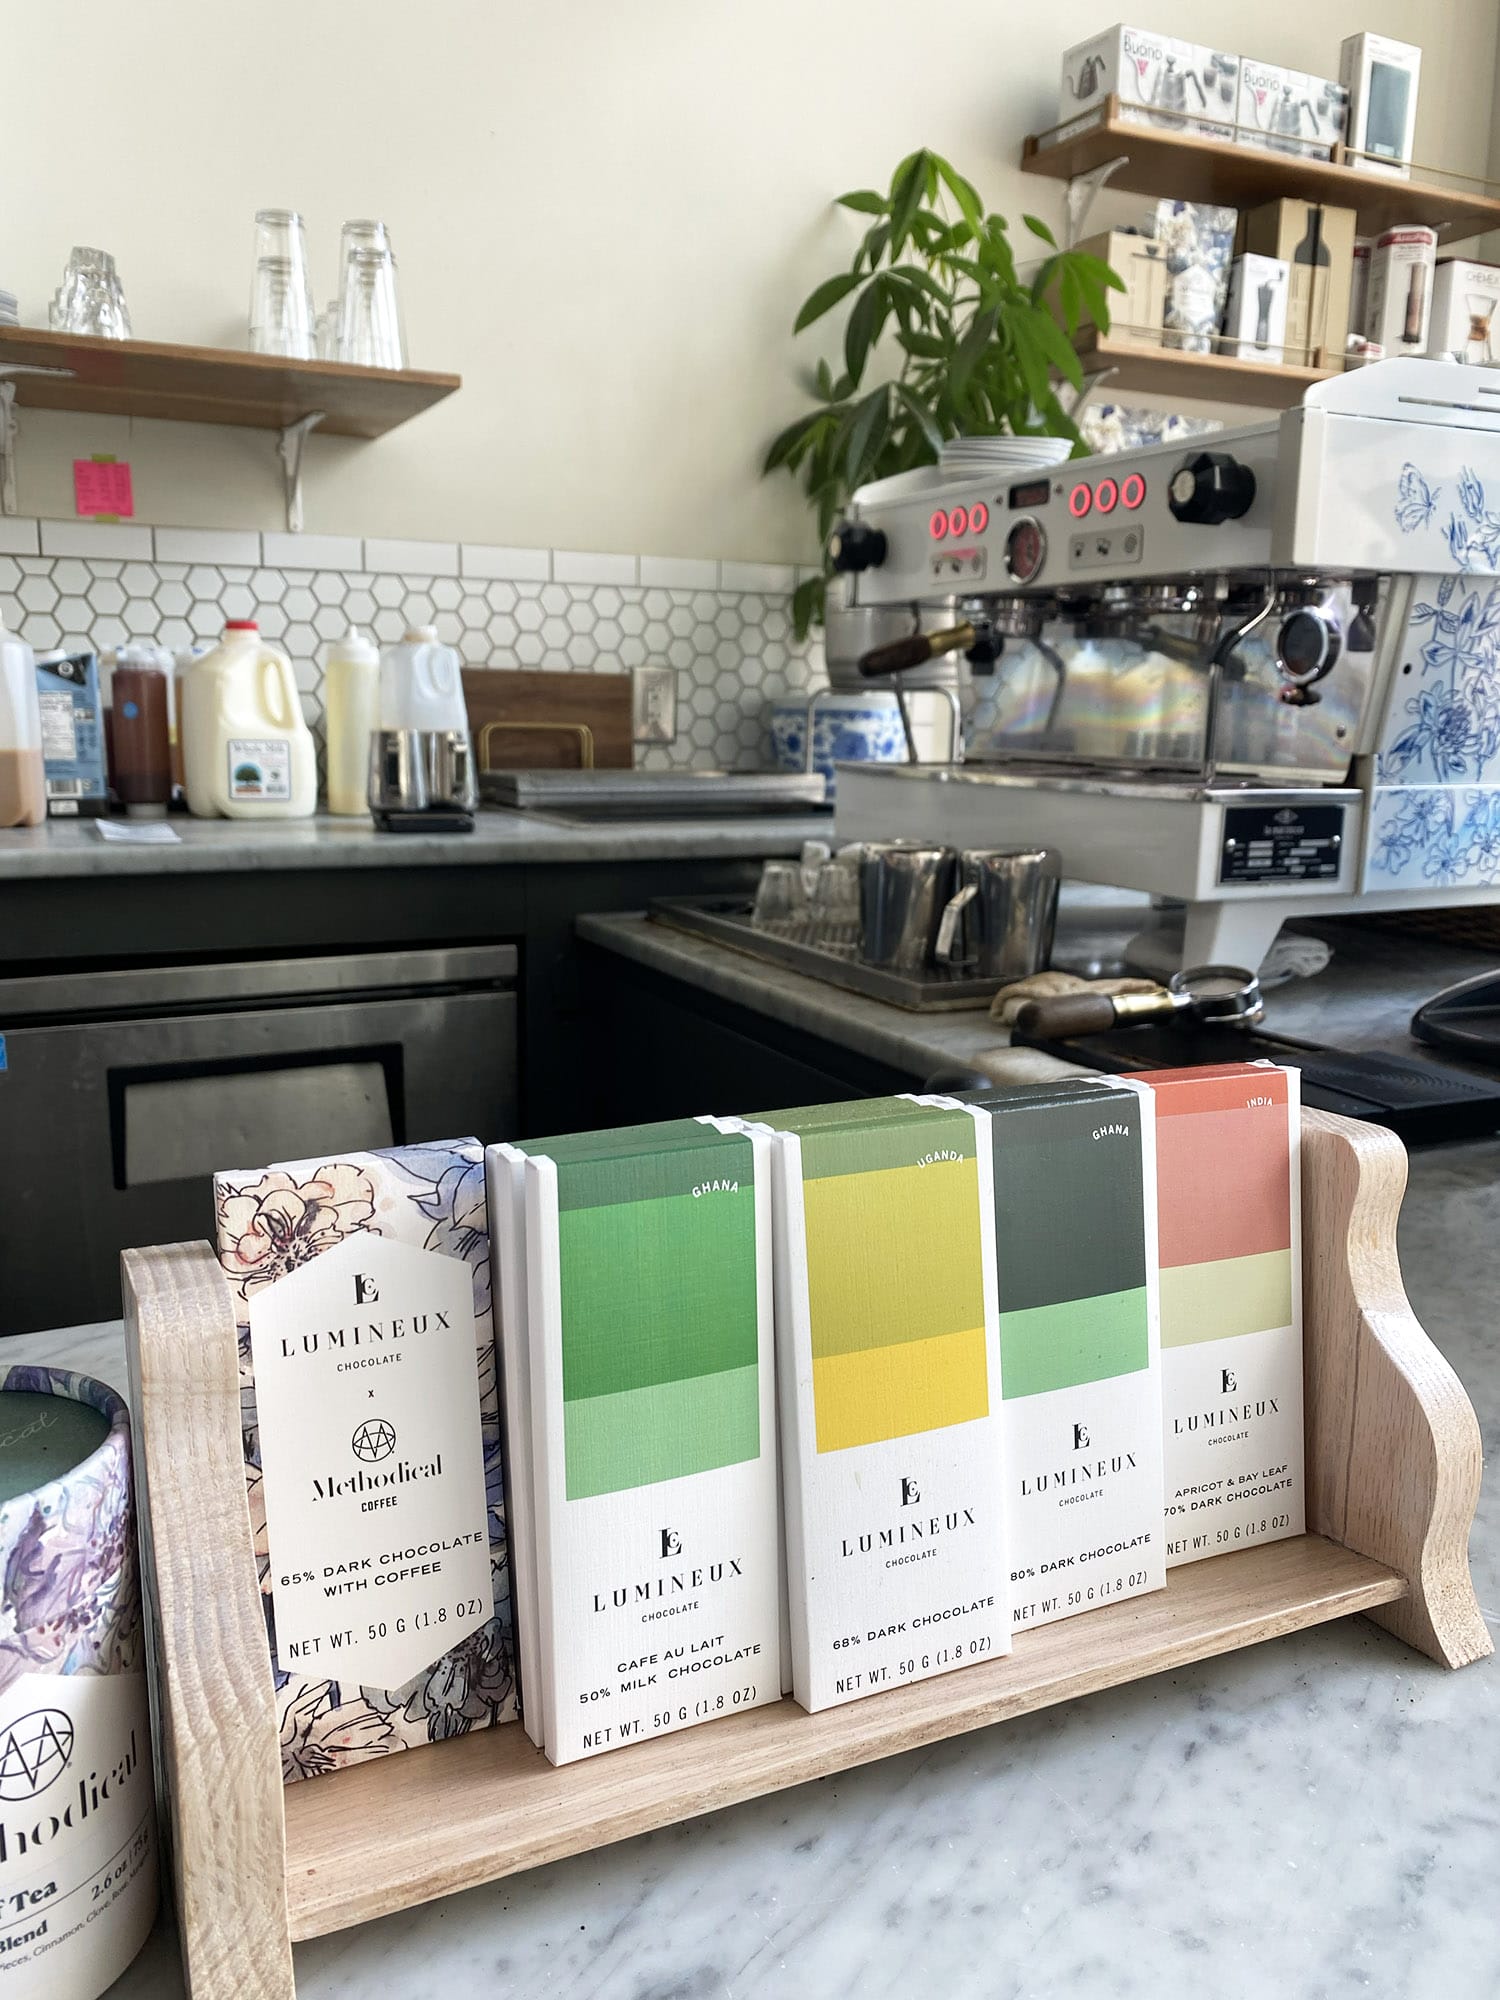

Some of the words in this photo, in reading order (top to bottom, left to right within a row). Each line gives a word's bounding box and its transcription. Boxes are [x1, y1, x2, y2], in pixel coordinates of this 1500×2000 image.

[1124, 34, 1162, 60] Buono
[1244, 67, 1280, 90] Buono
[1247, 1097, 1272, 1108] INDIA
[1093, 1124, 1128, 1140] GHANA
[917, 1150, 963, 1168] UGANDA
[692, 1180, 738, 1198] GHANA
[281, 1311, 450, 1357] LUMINEUX
[337, 1353, 402, 1372] CHOCOLATE
[1174, 1398, 1278, 1434] LUMINEUX
[1208, 1431, 1249, 1446] CHOCOLATE
[312, 1454, 442, 1501] Methodical
[1021, 1452, 1136, 1496] LUMINEUX
[1175, 1481, 1223, 1498] APRICOT
[1238, 1472, 1258, 1483] BAY
[1262, 1465, 1288, 1478] LEAF
[362, 1496, 397, 1512] COFFEE
[1059, 1489, 1104, 1507] CHOCOLATE
[1164, 1505, 1185, 1516] 70%
[1191, 1497, 1222, 1510] DARK
[1226, 1479, 1292, 1502] CHOCOLATE
[842, 1508, 975, 1557] LUMINEUX
[1167, 1540, 1187, 1555] NET
[1193, 1535, 1210, 1548] WT.
[1217, 1530, 1228, 1543] 50
[1234, 1527, 1240, 1538] G
[1246, 1520, 1266, 1536] (1.8
[1272, 1514, 1289, 1528] OZ)
[281, 1571, 315, 1586] 65%
[324, 1558, 372, 1577] DARK
[379, 1532, 483, 1564] CHOCOLATE
[885, 1549, 937, 1568] CHOCOLATE
[1011, 1568, 1035, 1581] 80%
[1041, 1557, 1075, 1573] DARK
[1079, 1534, 1151, 1563] CHOCOLATE
[324, 1579, 368, 1597] WITH
[375, 1562, 442, 1585] COFFEE
[594, 1558, 742, 1612] LUMINEUX
[1014, 1604, 1036, 1621] NET
[1042, 1598, 1060, 1613] WT.
[1068, 1591, 1081, 1605] 50
[1088, 1588, 1093, 1599] G
[1100, 1579, 1122, 1597] (1.8
[1129, 1571, 1147, 1587] OZ)
[289, 1638, 321, 1658] NET
[330, 1631, 358, 1649] WT.
[369, 1623, 387, 1639] 50
[397, 1619, 405, 1633] G
[415, 1608, 447, 1630] (1.8
[457, 1599, 483, 1618] OZ)
[642, 1601, 699, 1623] CHOCOLATE
[833, 1635, 860, 1650] 68%
[867, 1623, 906, 1641] DARK
[912, 1596, 994, 1628] CHOCOLATE
[618, 1655, 658, 1673] CAFE
[664, 1647, 684, 1661] AU
[691, 1636, 724, 1653] LAIT
[836, 1675, 861, 1694] NET
[869, 1667, 891, 1684] WT.
[899, 1660, 914, 1675] 50
[922, 1656, 929, 1668] G
[936, 1645, 962, 1665] (1.8
[970, 1636, 991, 1654] OZ)
[579, 1688, 610, 1704] 50%
[621, 1675, 657, 1692] MILK
[668, 1644, 761, 1679] CHOCOLATE
[583, 1728, 611, 1748] NET
[620, 1720, 644, 1737] WT.
[654, 1712, 670, 1727] 50
[679, 1707, 687, 1720] G
[695, 1696, 724, 1716] (1.8
[733, 1686, 756, 1704] OZ)
[9, 1881, 57, 1912] Tea
[92, 1876, 112, 1900] 2.6
[0, 1955, 31, 1971] ieces,
[33, 1923, 85, 1956] Cinnamon,
